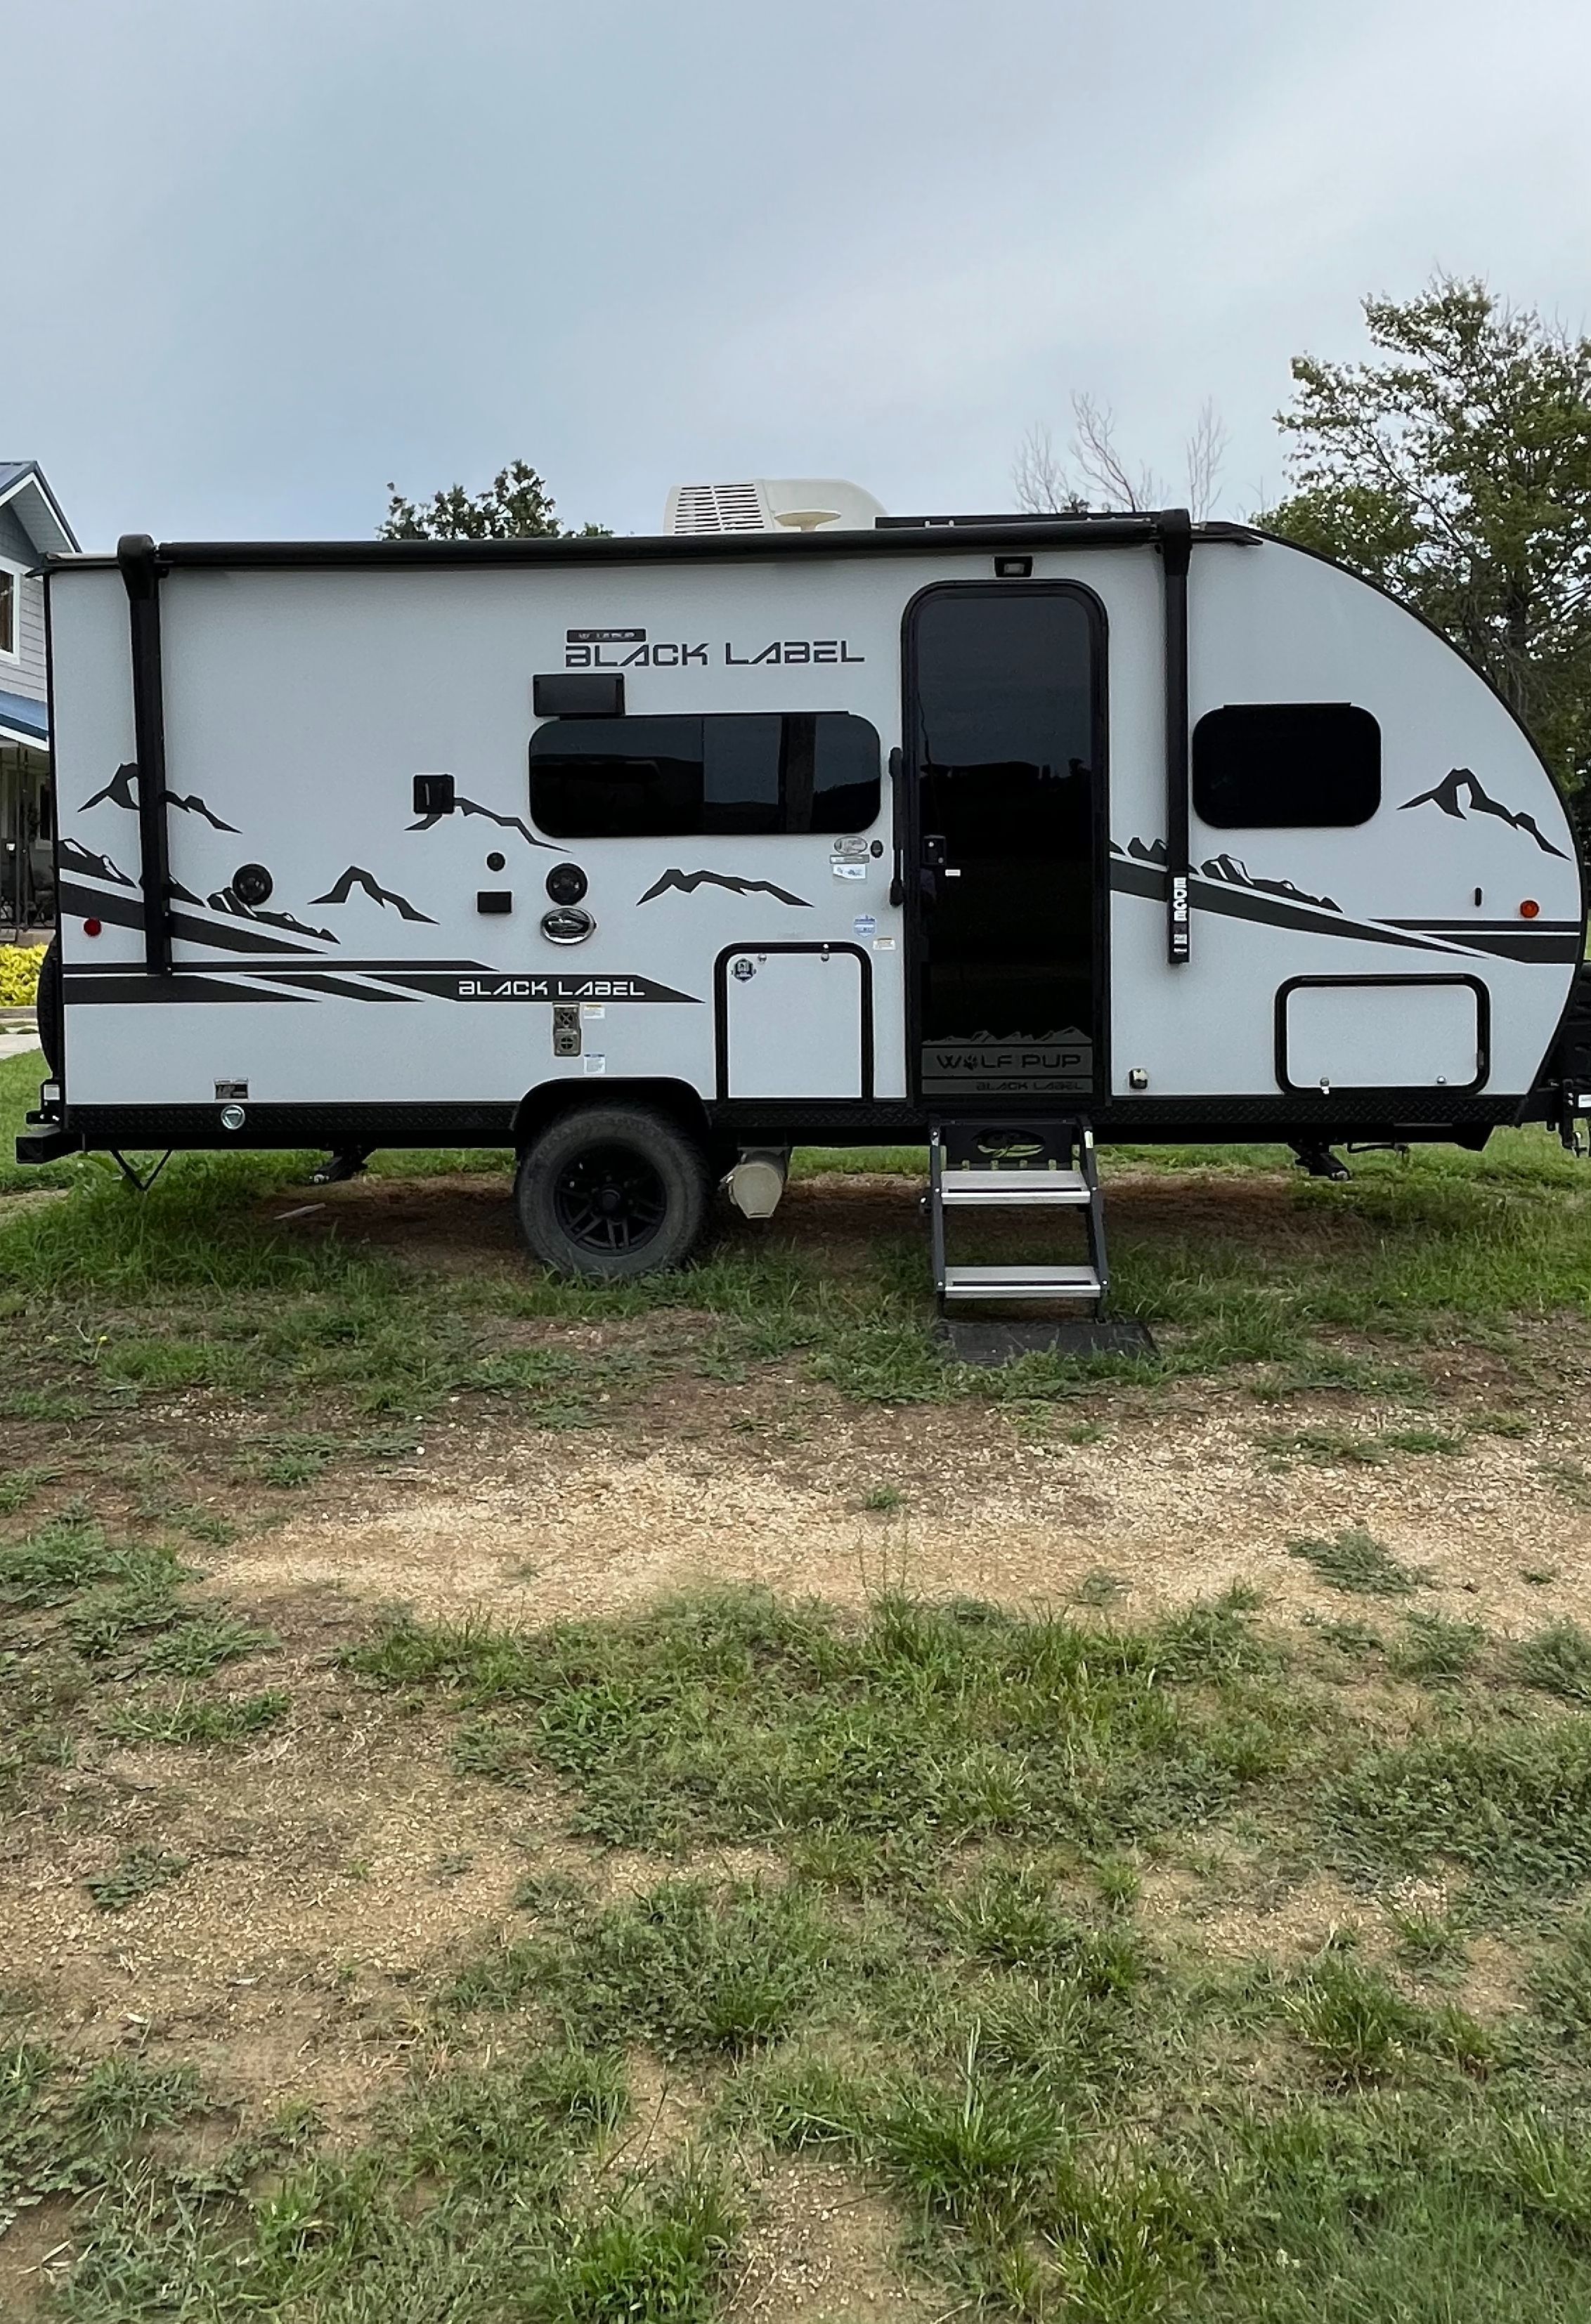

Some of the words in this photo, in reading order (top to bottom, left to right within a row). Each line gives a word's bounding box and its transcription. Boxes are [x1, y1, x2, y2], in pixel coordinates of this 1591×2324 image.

[565, 642, 710, 667] BLACK
[725, 640, 865, 665] LABEL
[458, 980, 548, 996] BLACK
[558, 981, 646, 996] LABEL
[936, 1054, 1013, 1071] WLF
[1021, 1054, 1082, 1069] PUP
[976, 1081, 1029, 1091] BLACK
[1033, 1081, 1084, 1091] LABEL
